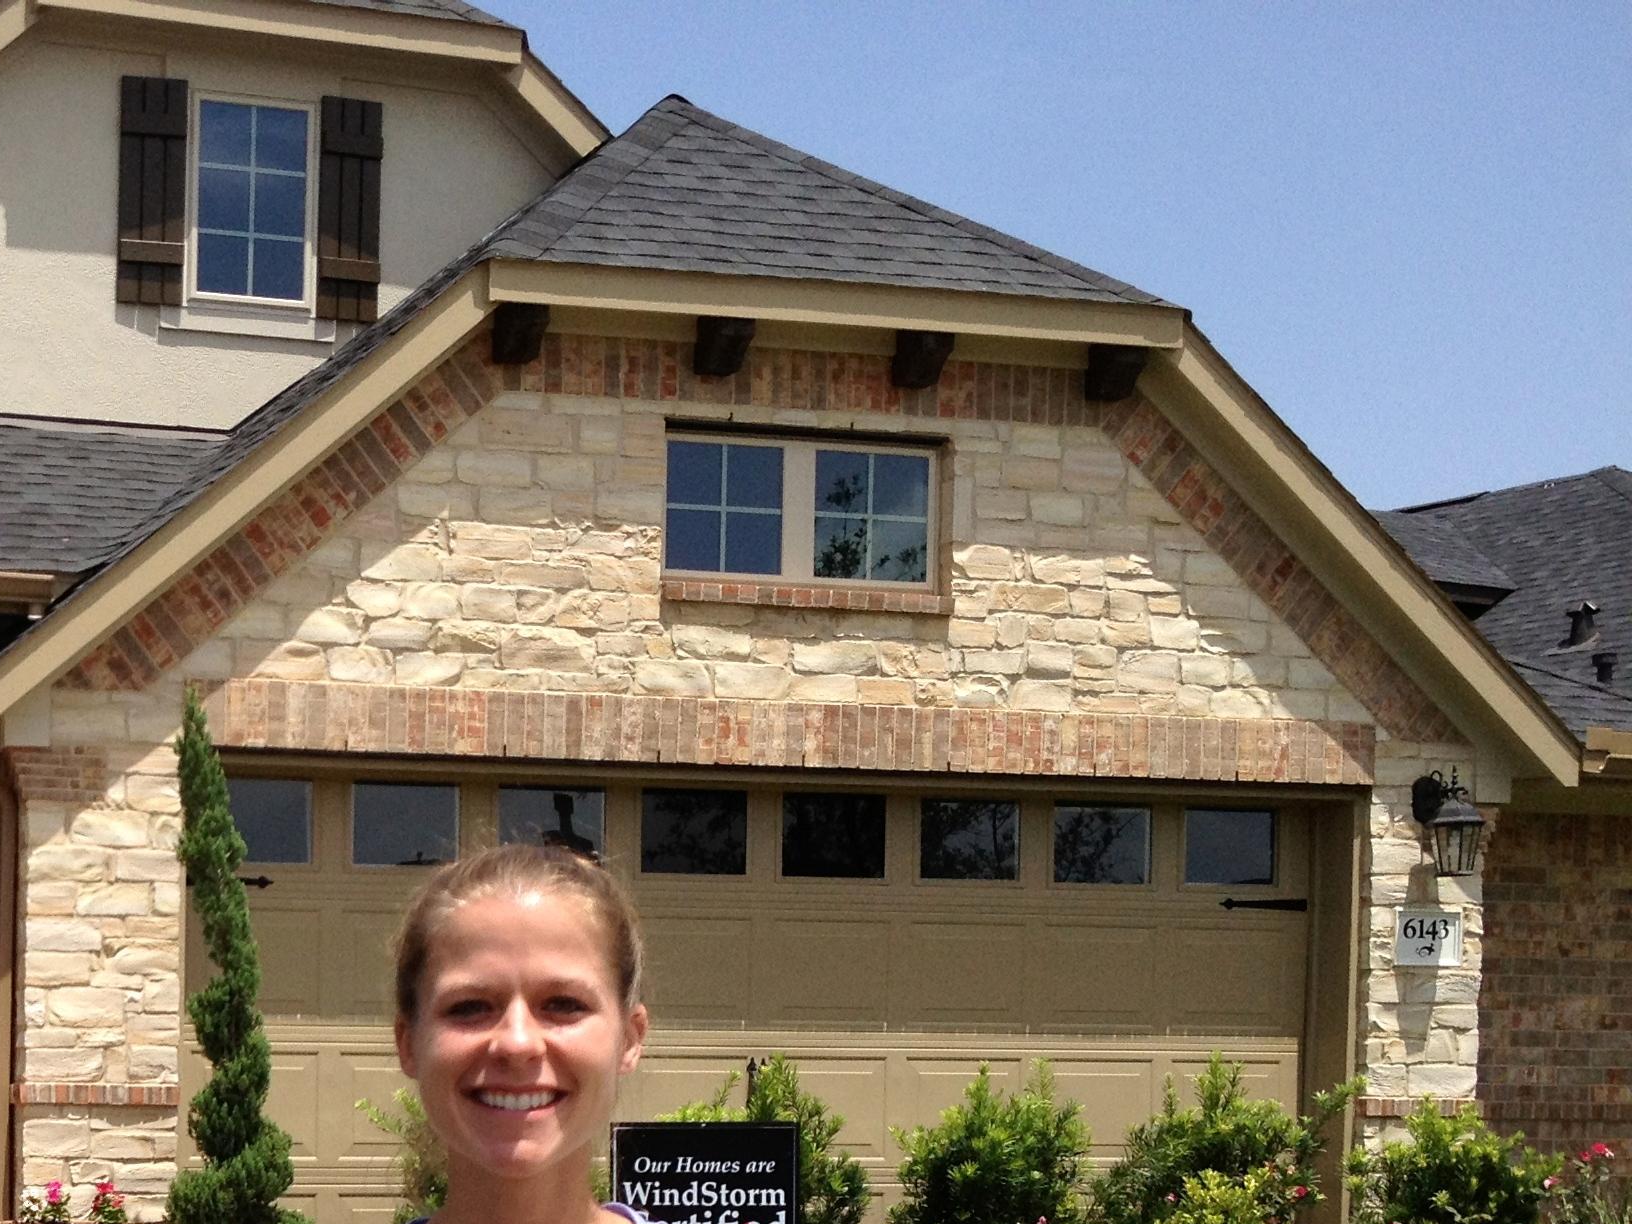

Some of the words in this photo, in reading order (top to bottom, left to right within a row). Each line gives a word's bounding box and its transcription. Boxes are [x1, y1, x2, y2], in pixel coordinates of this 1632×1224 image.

[1403, 918, 1450, 940] 6143
[634, 1156, 671, 1174] Our
[675, 1156, 740, 1174] Homes
[745, 1160, 776, 1174] are
[623, 1180, 787, 1207] WindStorm
